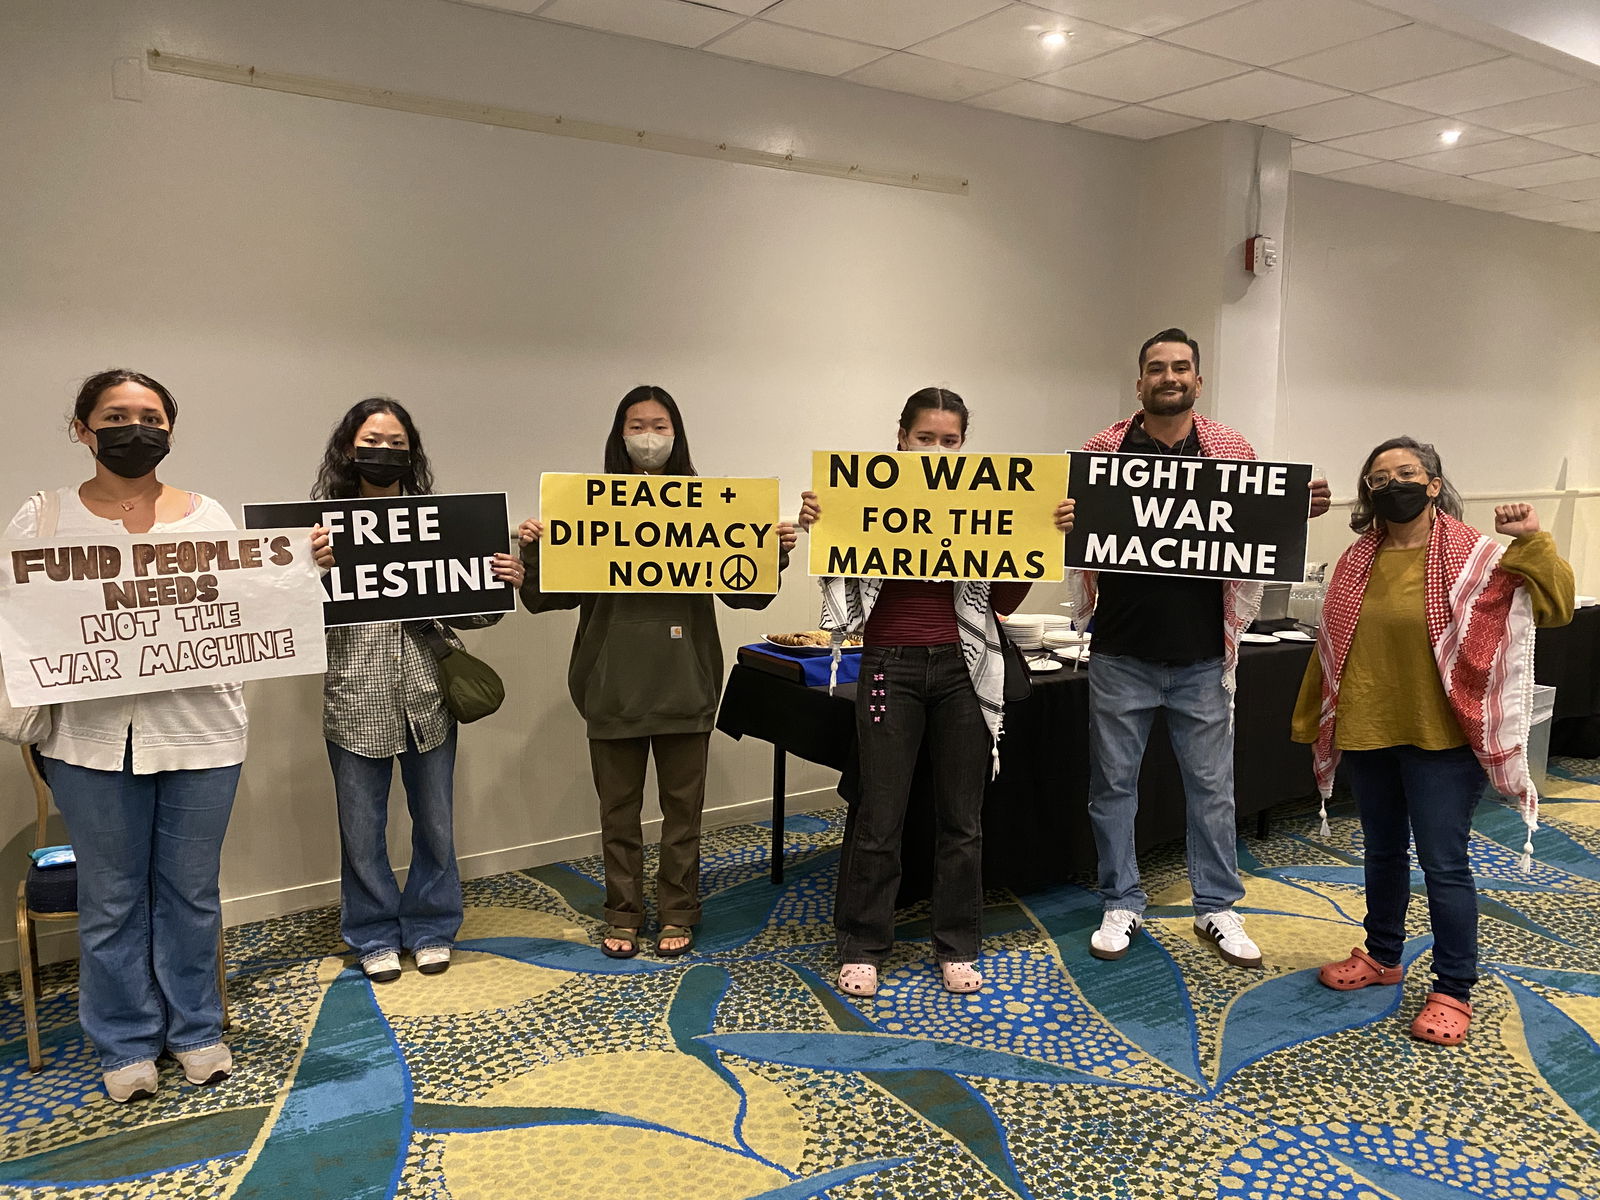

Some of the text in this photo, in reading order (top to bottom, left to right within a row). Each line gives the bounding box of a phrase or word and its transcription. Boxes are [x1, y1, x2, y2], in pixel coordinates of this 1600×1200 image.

[829, 453, 1035, 491] NO WAR
[1088, 457, 1288, 496] FIGHT THE
[586, 479, 737, 508] PEACE +
[321, 506, 441, 546] FREE
[549, 519, 773, 548] DIPLOMACY
[862, 507, 1014, 536] FOR THE
[1131, 495, 1235, 534] WAR
[11, 536, 294, 584] FUND PEOPLE'S
[608, 560, 713, 587] NOW!
[828, 538, 1045, 579] MARIÅNAS
[1084, 533, 1277, 575] MACHINE
[102, 574, 219, 611] NEEDS
[320, 556, 505, 602] LESTINE
[81, 602, 242, 645] NOT THE
[30, 628, 296, 688] WAR MACHINE
